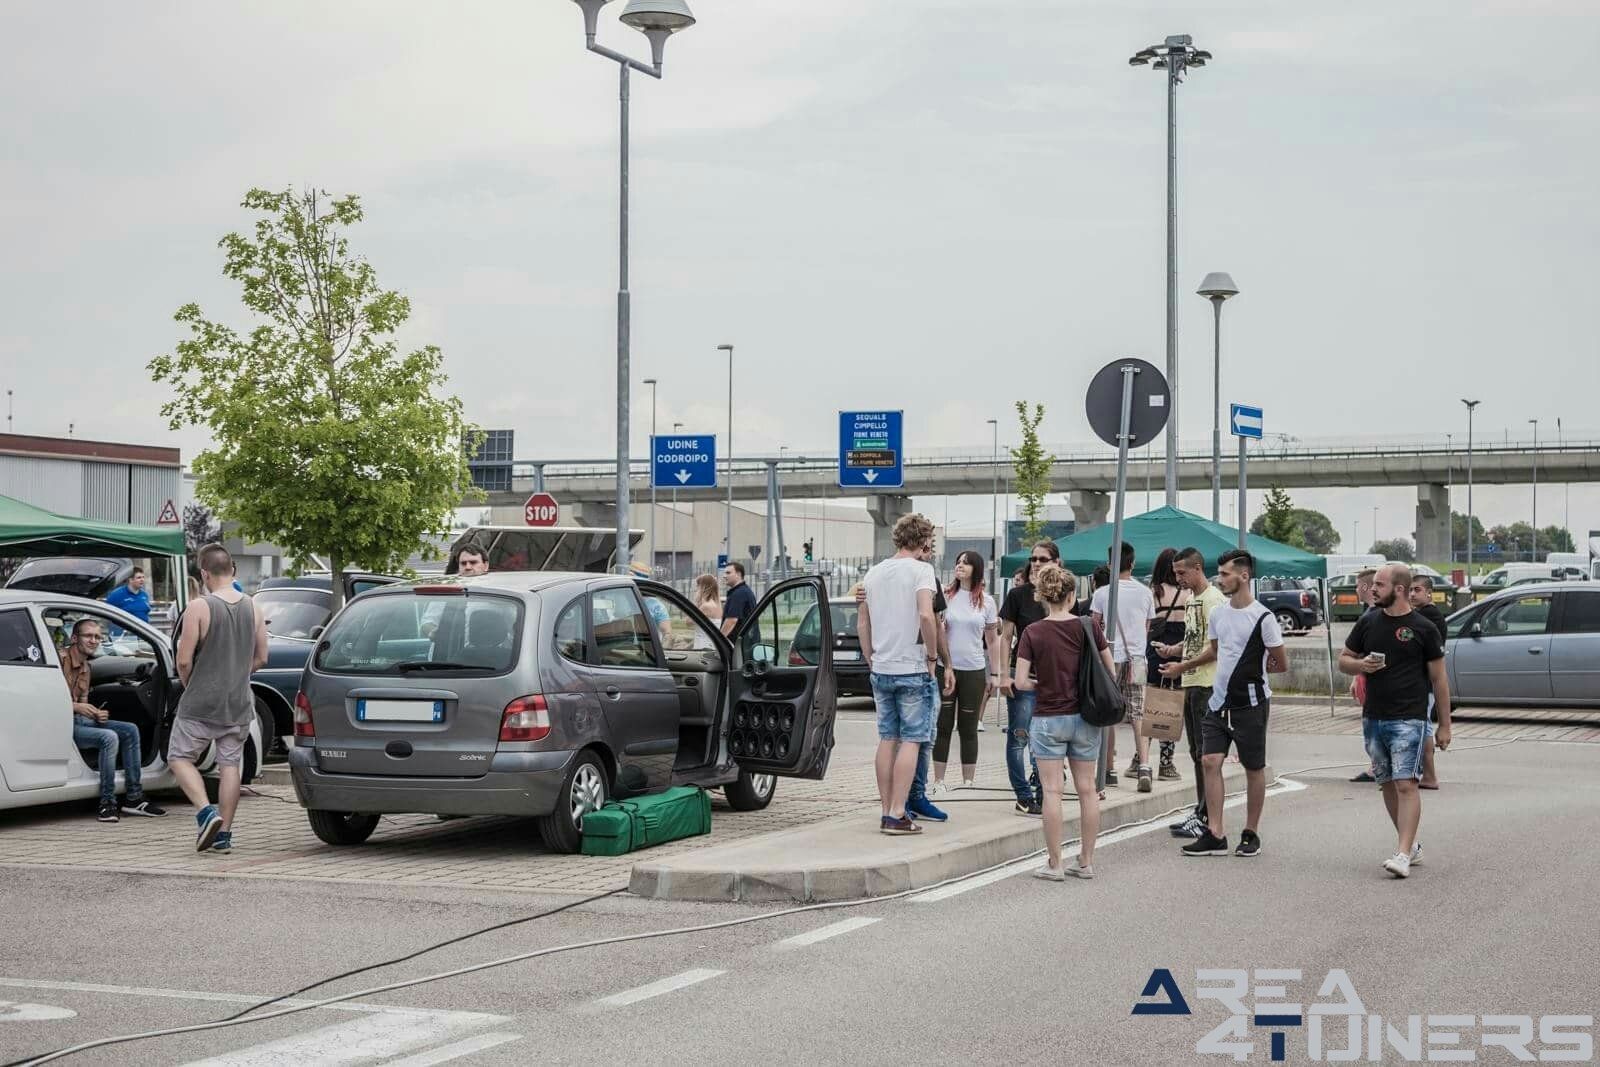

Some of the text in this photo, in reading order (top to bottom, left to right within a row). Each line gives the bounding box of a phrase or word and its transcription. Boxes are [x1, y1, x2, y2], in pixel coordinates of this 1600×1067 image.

[667, 440, 698, 449] UDINE
[657, 454, 708, 463] CODROIPO
[526, 506, 556, 521] STOP
